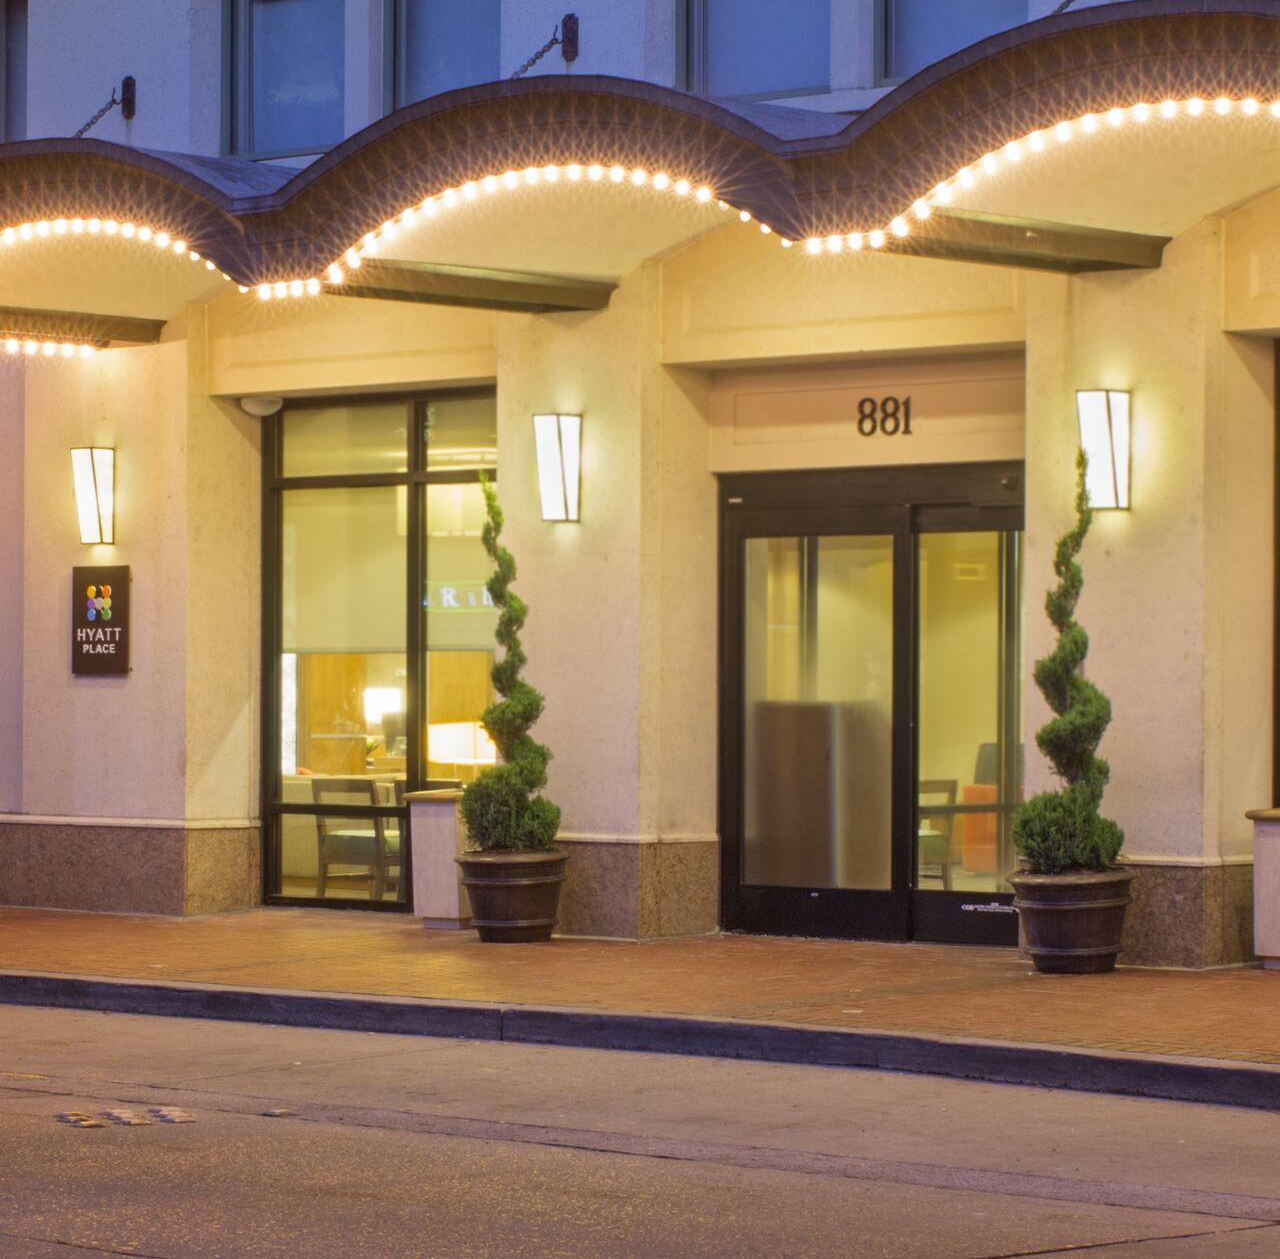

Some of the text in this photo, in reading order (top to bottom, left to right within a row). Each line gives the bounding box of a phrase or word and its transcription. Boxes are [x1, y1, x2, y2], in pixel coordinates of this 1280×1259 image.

[857, 395, 912, 437] 881
[76, 627, 122, 641] HYATT
[82, 643, 116, 654] PLACE
